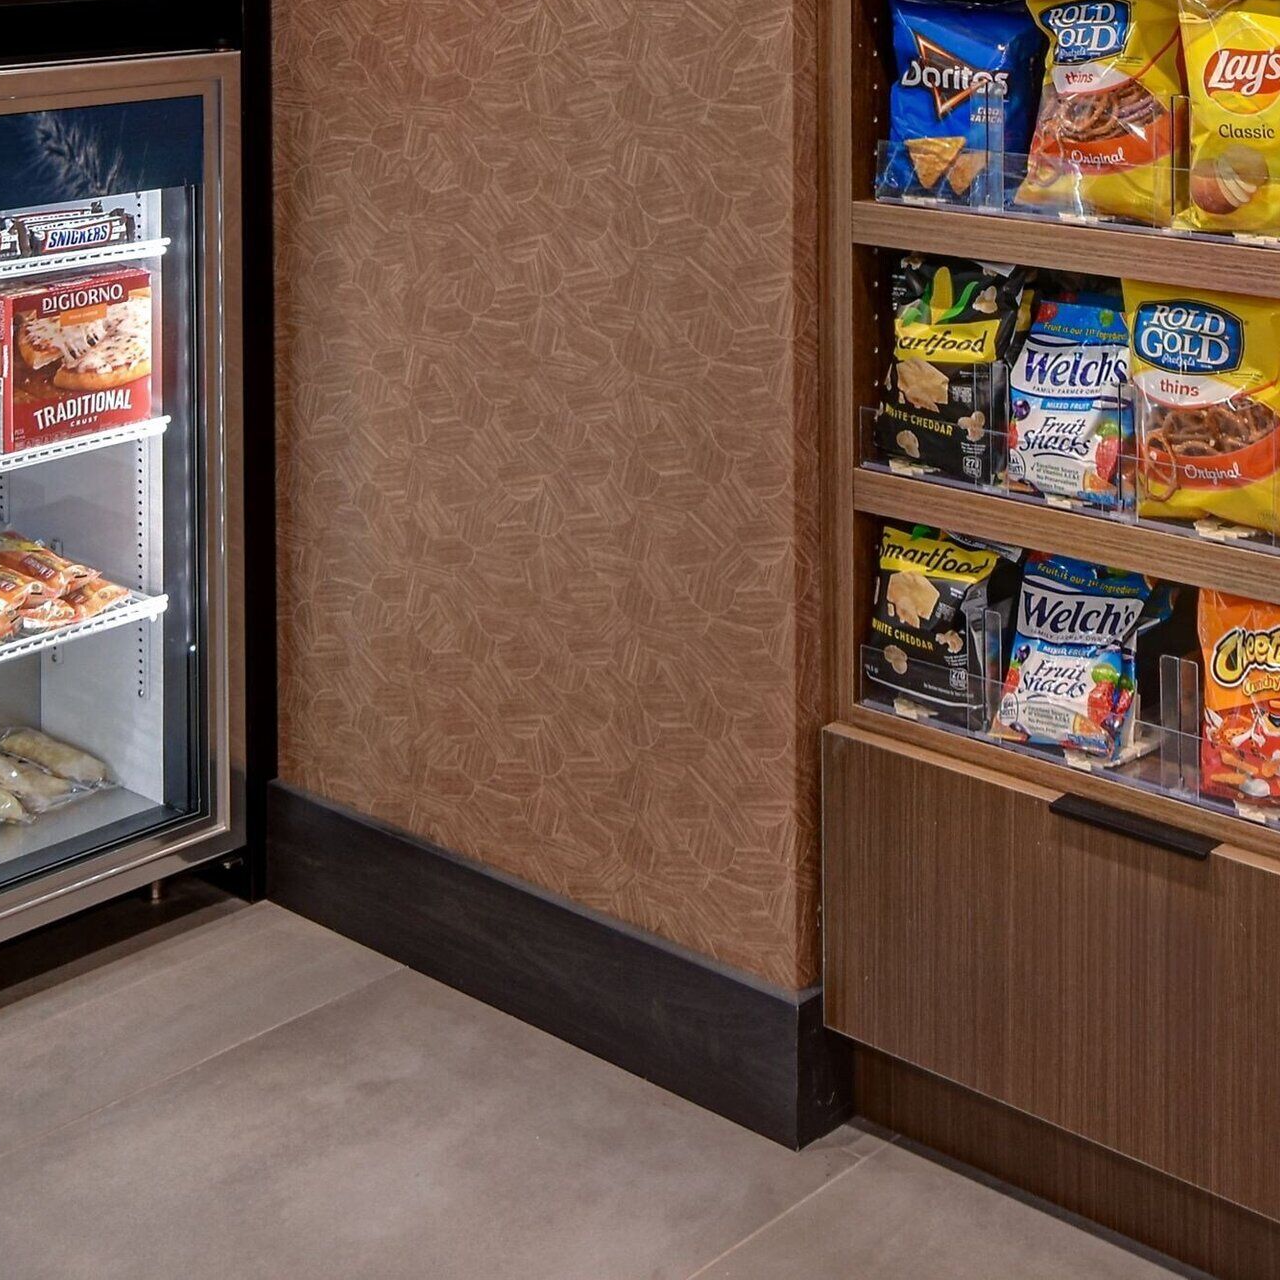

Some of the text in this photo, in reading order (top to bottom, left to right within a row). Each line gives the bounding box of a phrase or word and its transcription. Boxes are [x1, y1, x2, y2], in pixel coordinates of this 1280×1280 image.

[1048, 2, 1115, 24] ROLD
[902, 61, 1008, 96] Doritos
[1065, 70, 1093, 86] thins
[1219, 123, 1275, 140] Classic
[1071, 148, 1125, 165] Original
[47, 224, 109, 249] SNICKERS
[1152, 304, 1226, 338] ROLD
[1141, 329, 1231, 366] GOLD
[1024, 347, 1128, 387] Welch's
[1160, 379, 1200, 397] thins
[34, 389, 132, 429] TRADITIONAL
[70, 416, 98, 427] CRUST
[1019, 430, 1090, 457] Snacks
[1184, 462, 1241, 486] Original
[1022, 590, 1136, 636] Welch's
[894, 628, 933, 651] CHEDDAR
